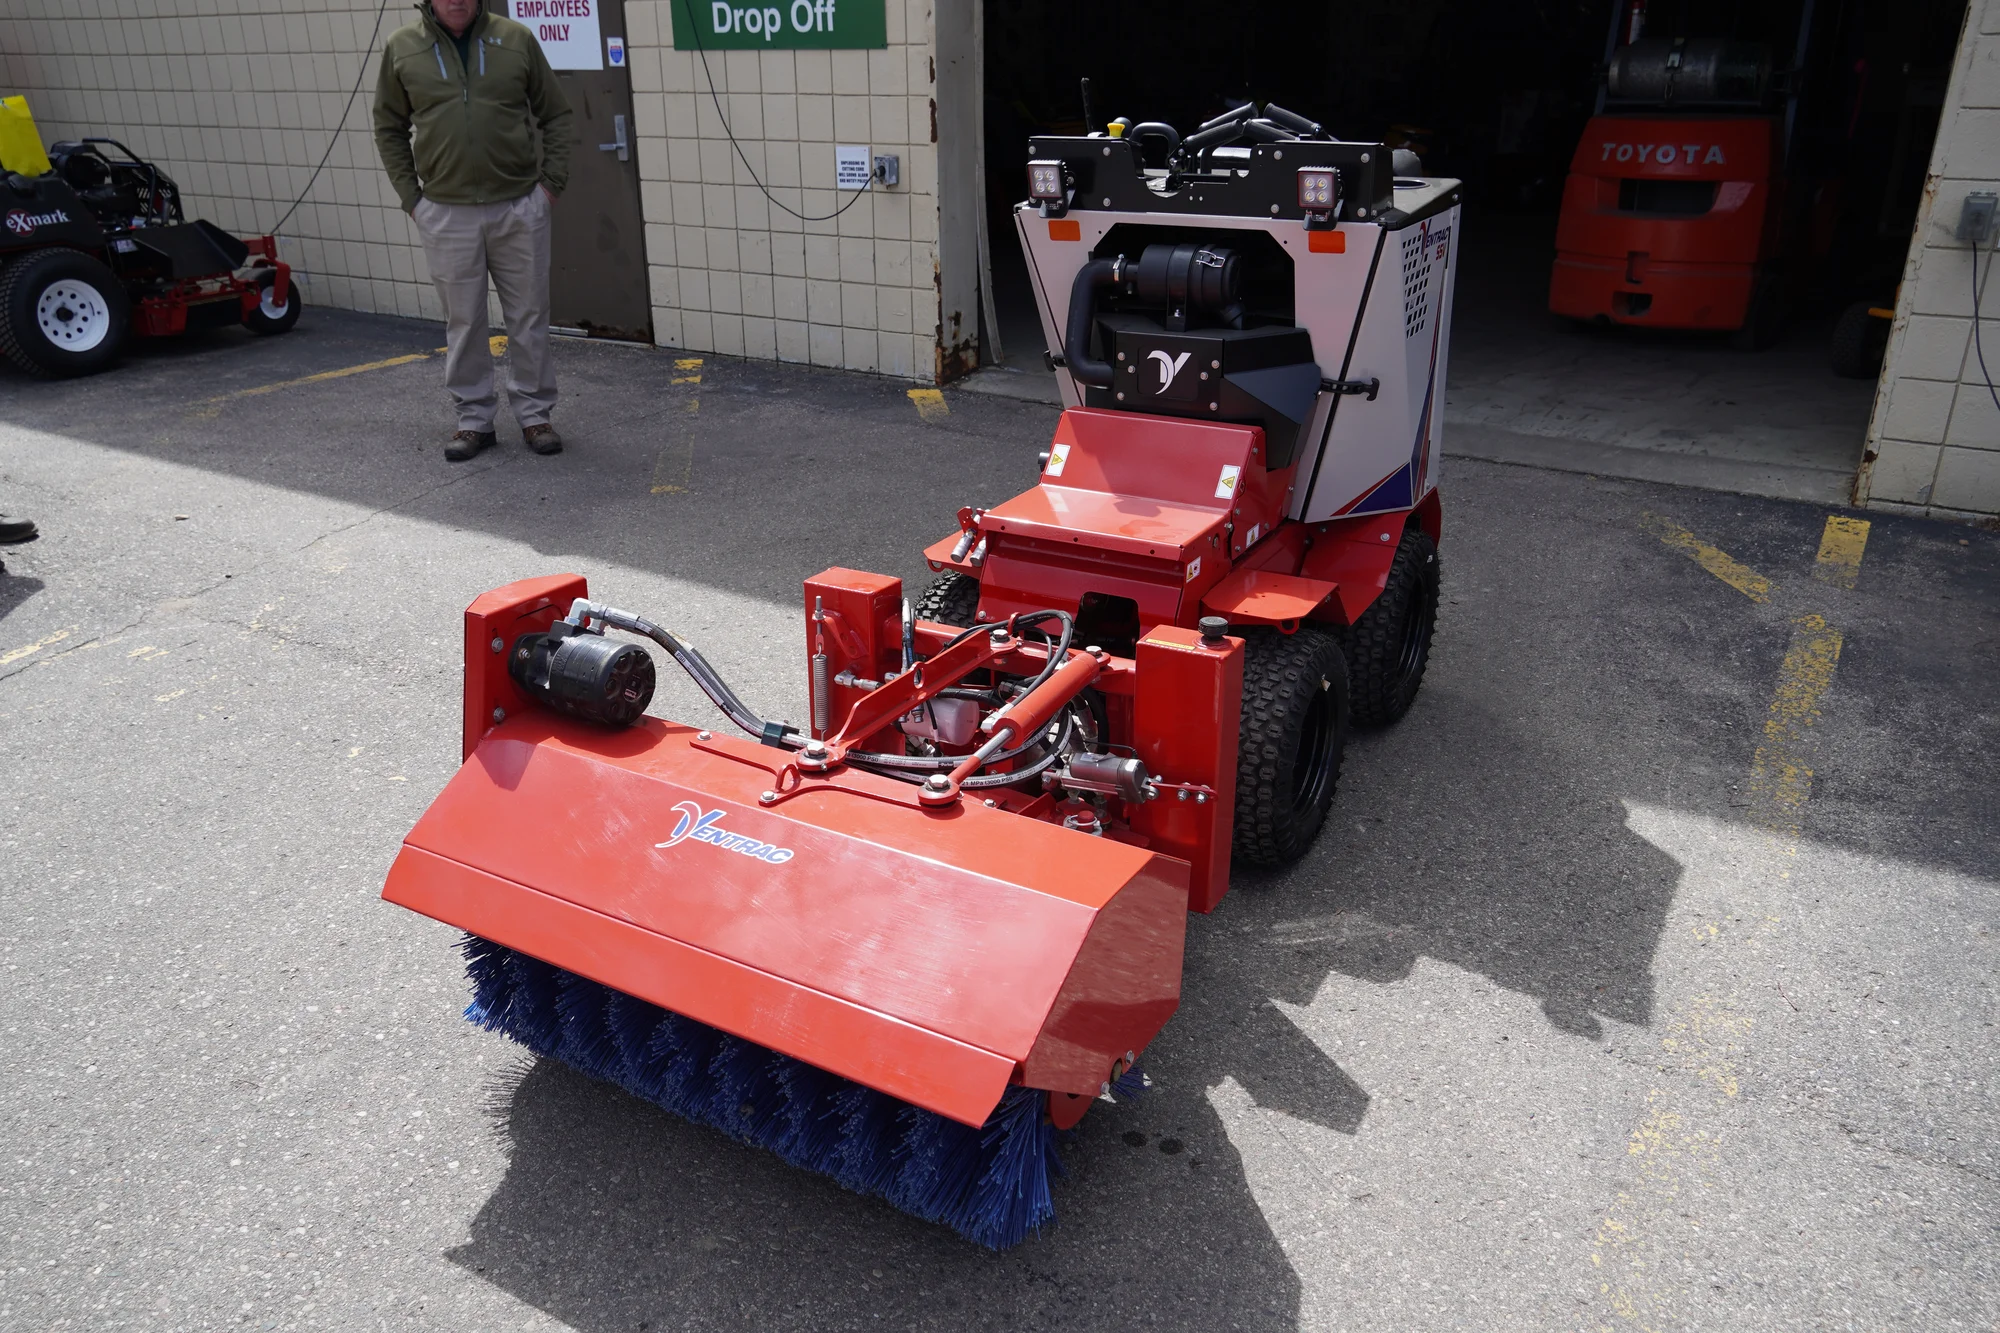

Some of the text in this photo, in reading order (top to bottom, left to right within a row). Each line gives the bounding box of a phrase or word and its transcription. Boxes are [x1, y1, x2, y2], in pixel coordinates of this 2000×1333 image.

[516, 0, 591, 18] EMPLOYEES
[711, 0, 836, 42] Drop Off
[539, 24, 570, 42] ONLY
[1602, 143, 1725, 165] TOYOTA
[6, 209, 70, 233] eXmark
[655, 800, 795, 864] VENTRAC
